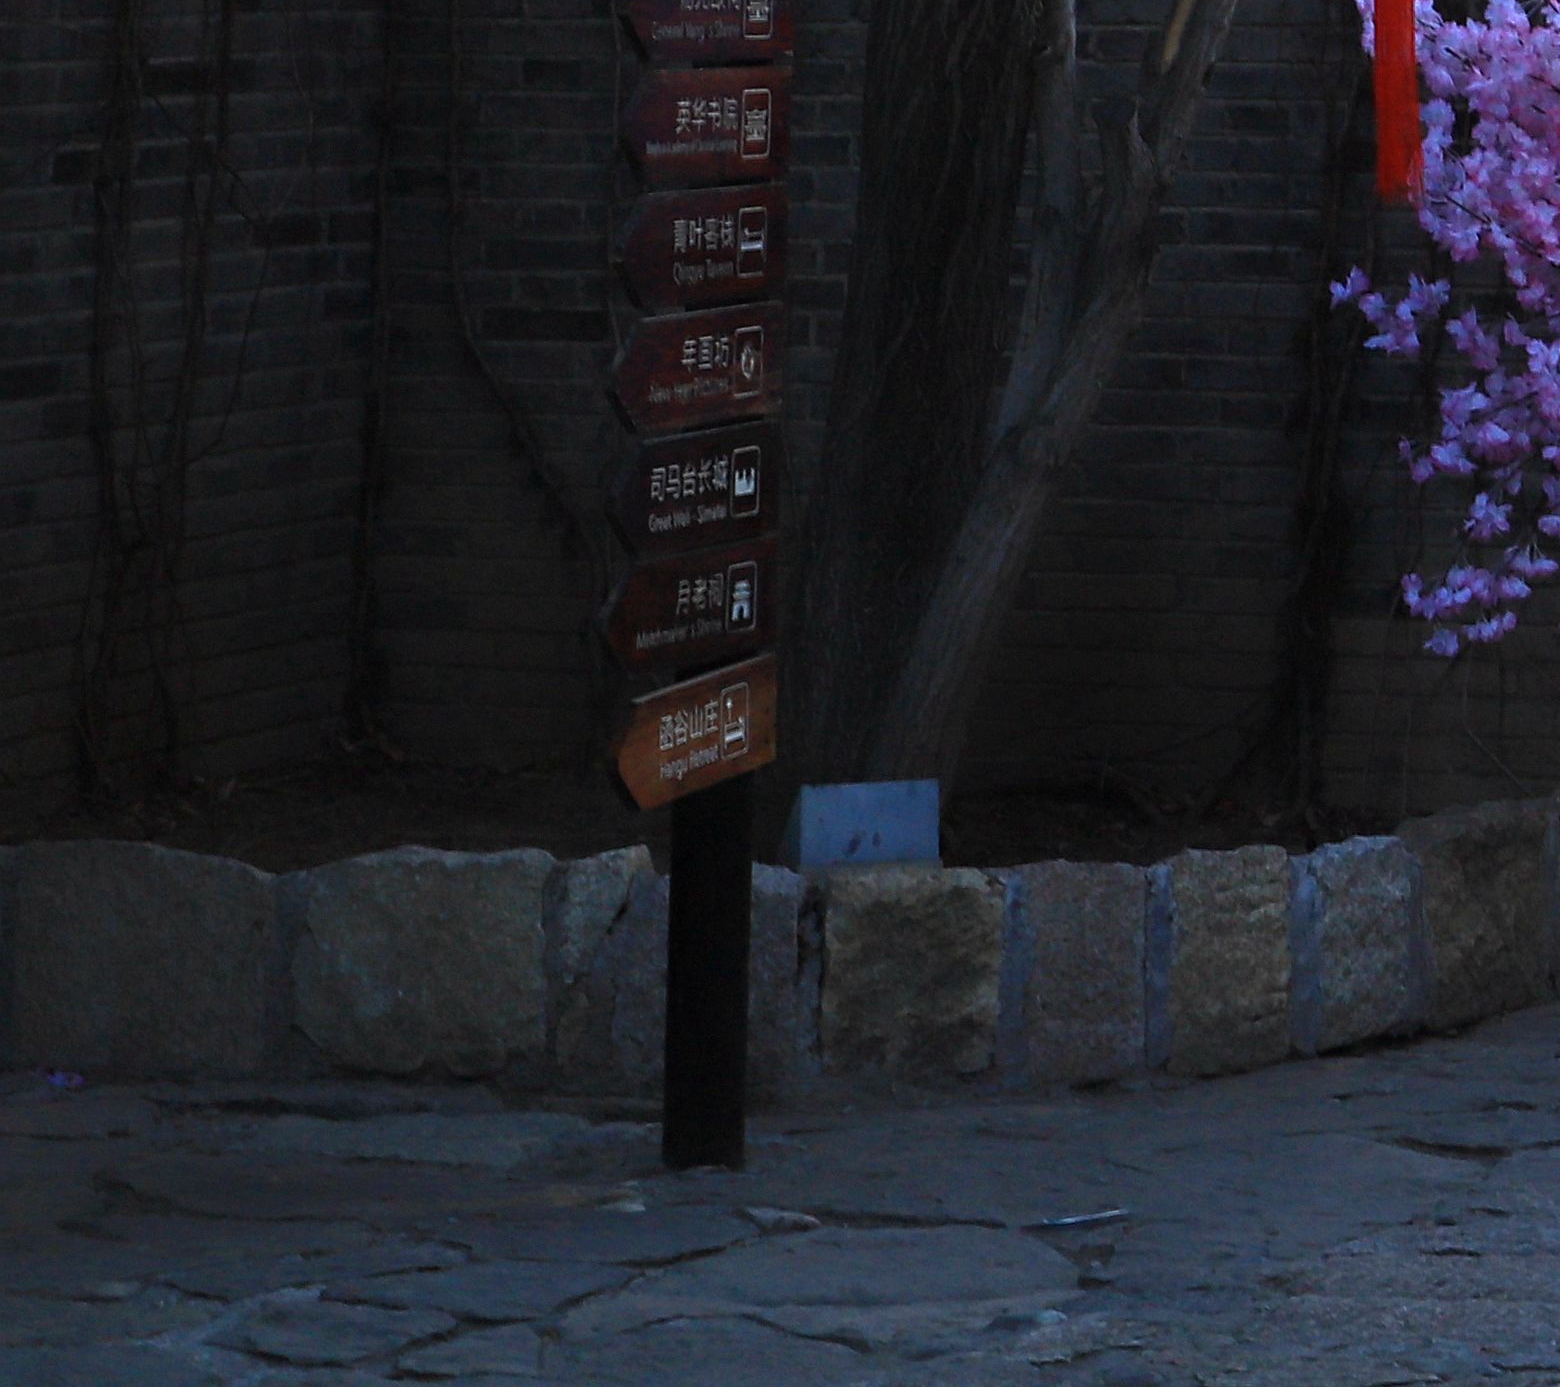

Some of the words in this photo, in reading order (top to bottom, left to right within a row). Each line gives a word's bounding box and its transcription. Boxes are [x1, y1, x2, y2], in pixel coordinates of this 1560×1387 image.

[675, 97, 738, 134] 英华书院
[673, 214, 735, 253] 青叶客栈
[681, 334, 730, 373] 年画坊
[651, 455, 729, 501] 司马台长城
[676, 573, 724, 615] 月老祠
